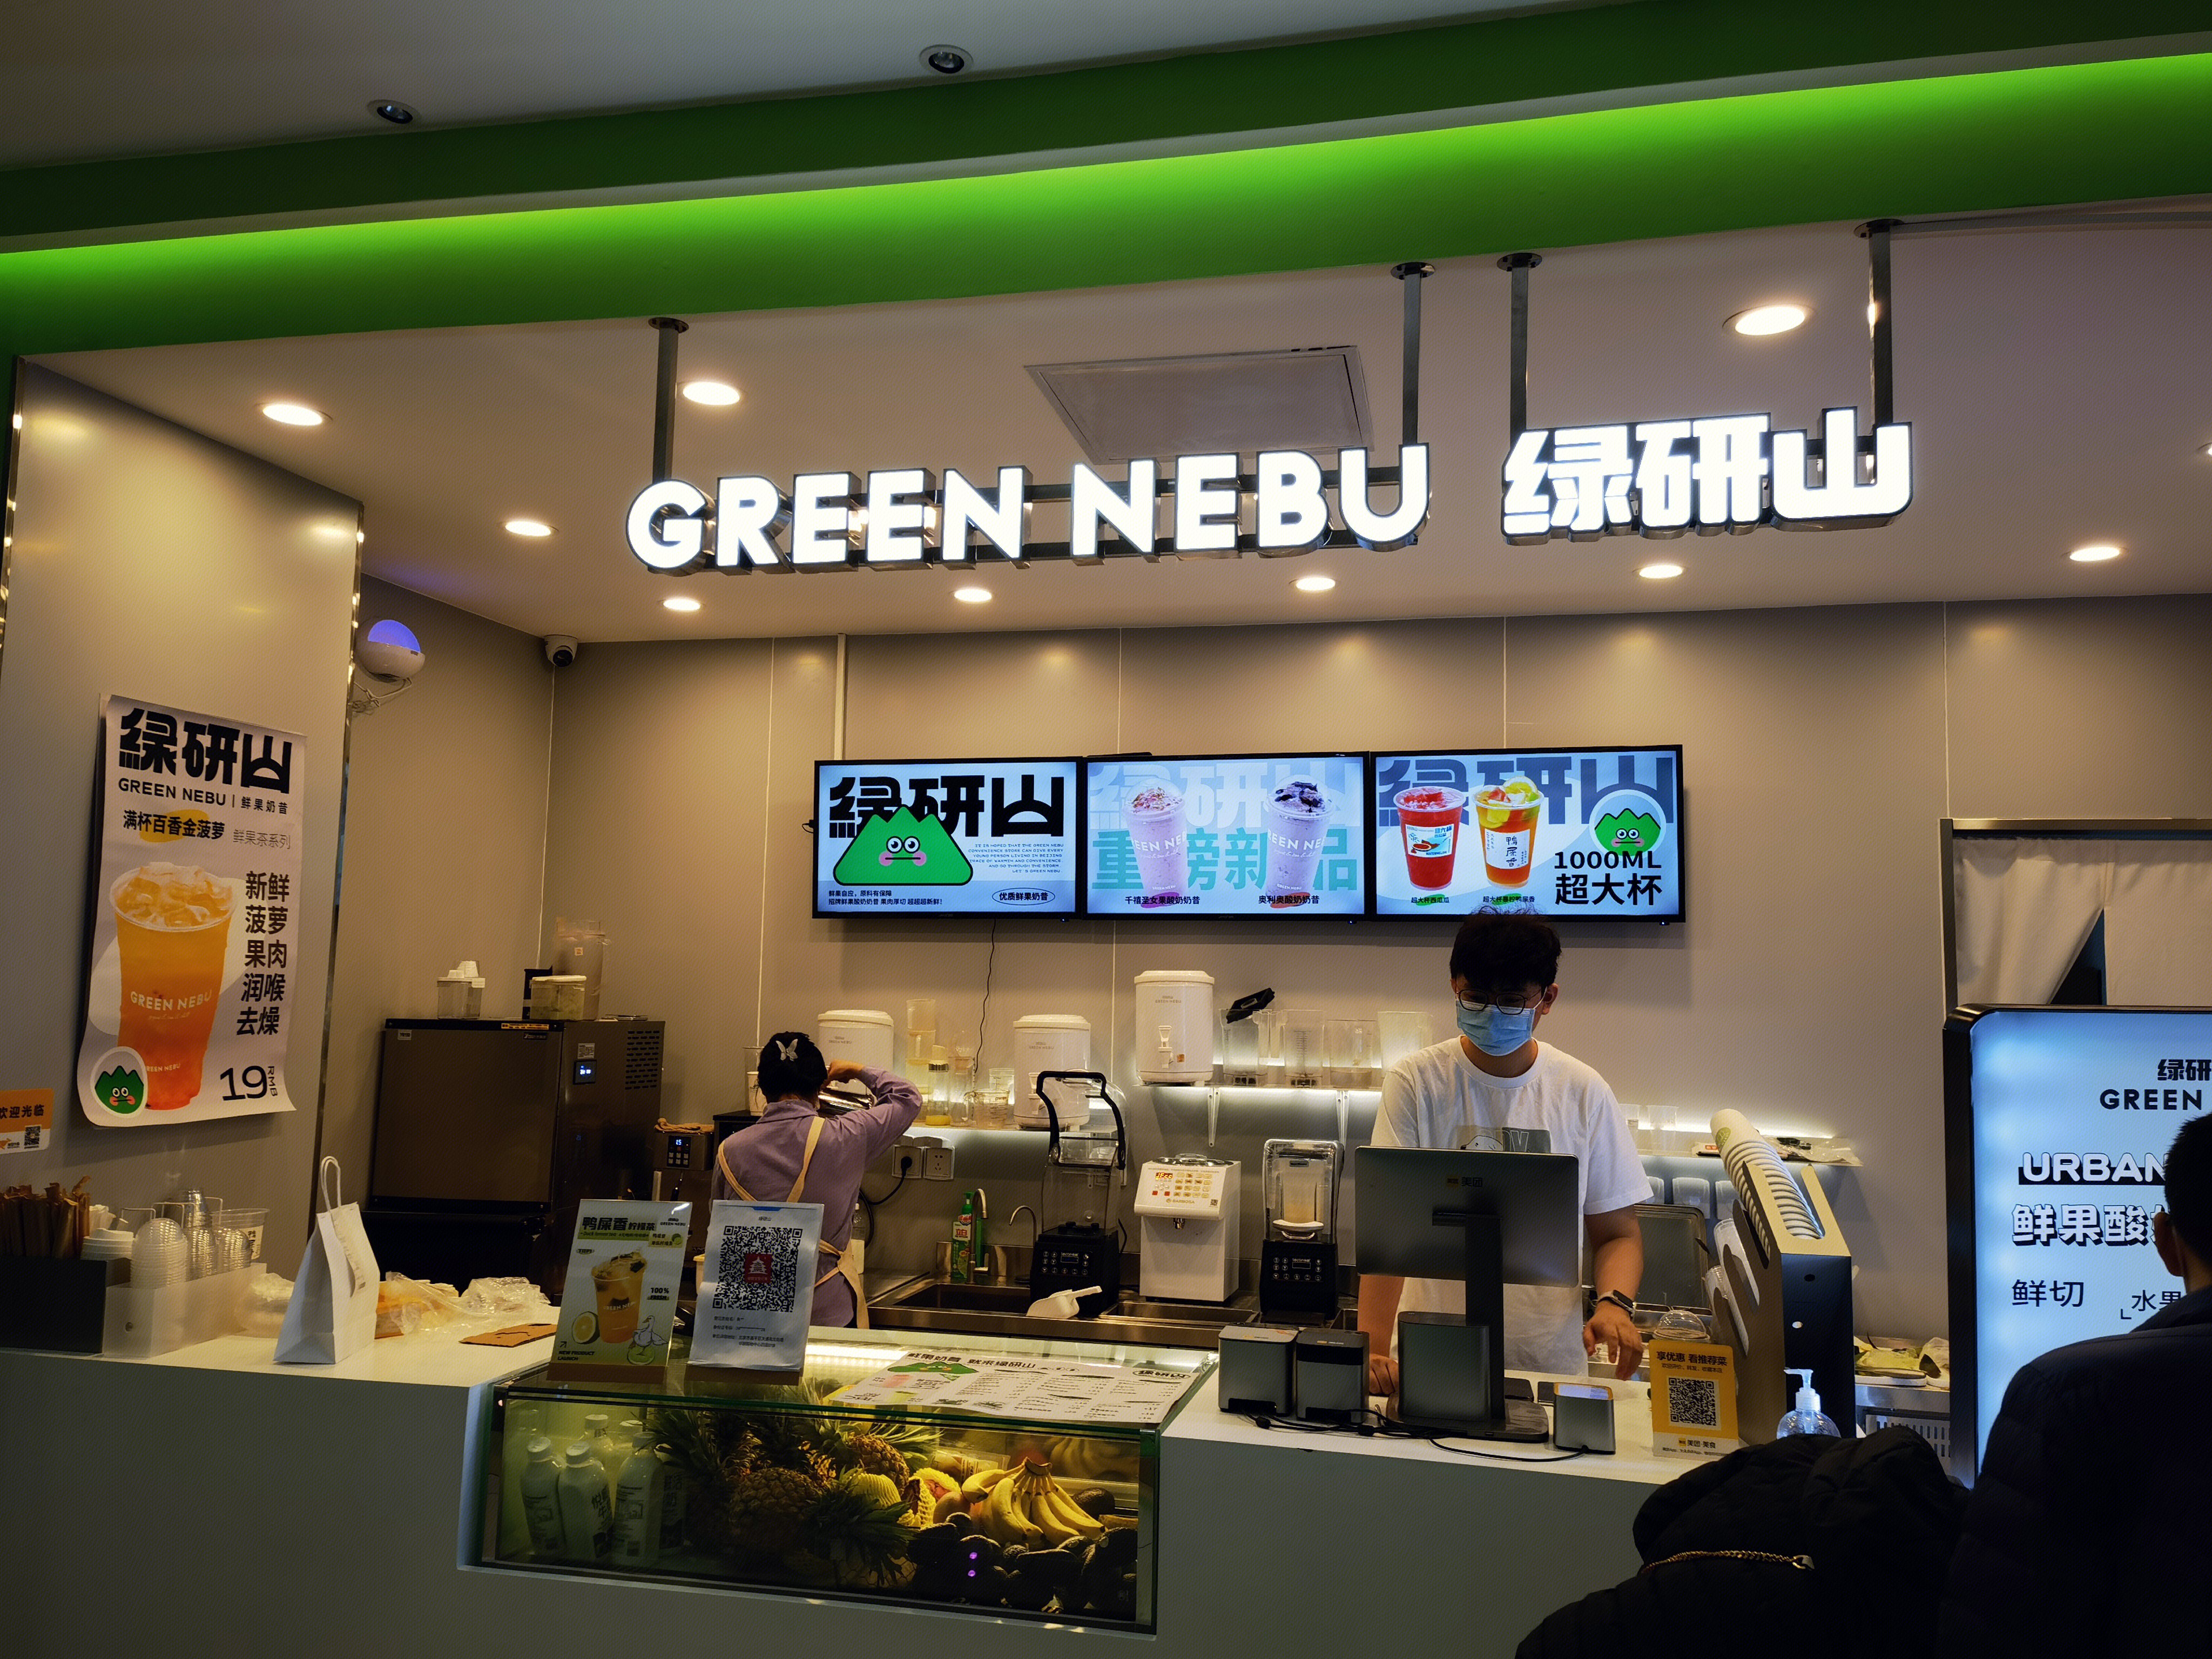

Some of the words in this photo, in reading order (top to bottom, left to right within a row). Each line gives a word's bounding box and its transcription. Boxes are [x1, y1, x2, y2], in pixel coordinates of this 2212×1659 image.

[1503, 409, 1912, 535] 绿研山
[626, 466, 1024, 570] GREEN
[1070, 444, 1430, 557] NEBU
[119, 707, 292, 794] 绿研山
[118, 778, 176, 799] GREEN
[183, 788, 226, 806] NEBU
[241, 796, 288, 814] 鲜果奶昔
[123, 809, 225, 840] 满杯百香金菠萝
[233, 828, 291, 849] 鲜果茶系列
[1267, 828, 1298, 850] REEN
[1554, 851, 1662, 869] 1000ML
[245, 871, 290, 902] 新鲜
[999, 892, 1048, 901] 优质鲜果奶昔
[1554, 873, 1663, 906] 超大杯
[1125, 896, 1200, 905] 千禧圣女果酸奶奶昔
[1258, 895, 1320, 904] 奥利奥酸奶奶昔
[245, 905, 288, 935] 菠萝
[245, 940, 287, 969] 果肉
[130, 991, 173, 1011] GREEN
[177, 989, 212, 1010] NEBU
[240, 973, 286, 1002] 润喉
[237, 1006, 280, 1036] 去燥
[2157, 1059, 2212, 1081] 绿研
[220, 1065, 267, 1101] 19
[267, 1066, 278, 1097] RMB
[0, 1104, 44, 1119] 欢迎光临
[2100, 1089, 2202, 1110] GREEN
[2022, 1152, 2169, 1183] URBAN
[1461, 1177, 1483, 1187] 美团
[2012, 1279, 2084, 1307] 鲜切
[907, 1353, 961, 1363] 鲜果奶昔
[1656, 1351, 1685, 1362] 享优惠
[1688, 1353, 1728, 1366] 看推荐菜
